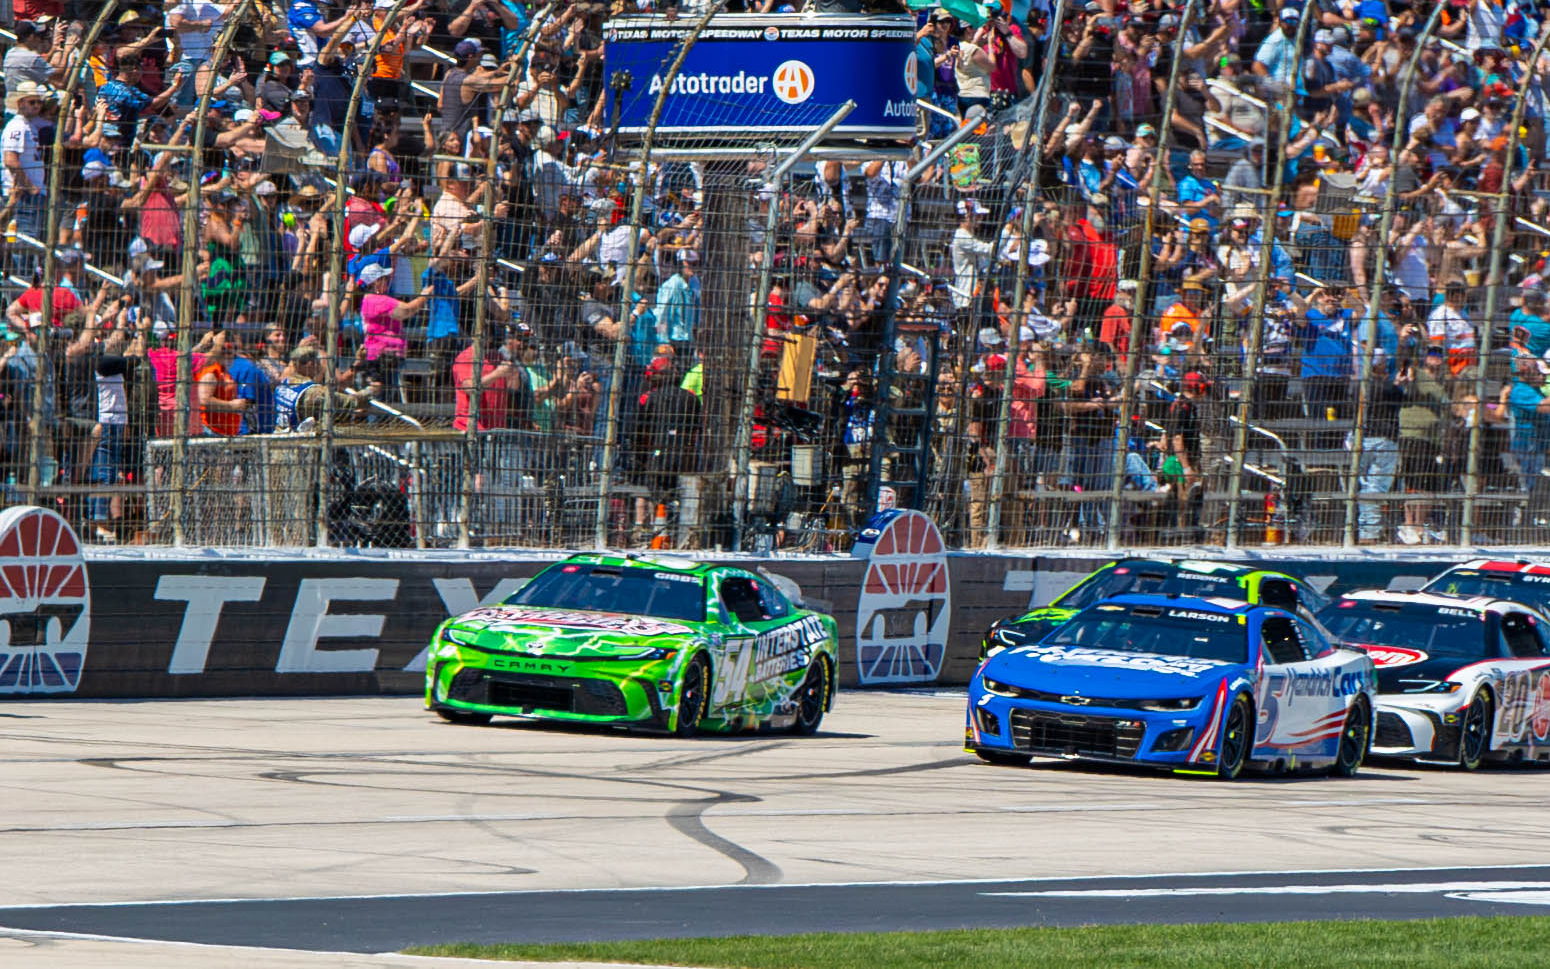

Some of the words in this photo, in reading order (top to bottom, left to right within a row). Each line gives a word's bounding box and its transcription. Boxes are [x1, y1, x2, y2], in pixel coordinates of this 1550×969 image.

[651, 30, 693, 39] MOTO
[699, 30, 763, 38] SPEEDWAY
[780, 29, 819, 38] TEXAS
[822, 29, 868, 38] MOTOR
[1177, 572, 1229, 583] REDDICK
[1168, 609, 1230, 623] LARSON
[1437, 606, 1478, 618] BELL
[755, 615, 829, 664] INTERSTATE
[493, 659, 570, 673] CAMRY
[713, 638, 754, 704] 54
